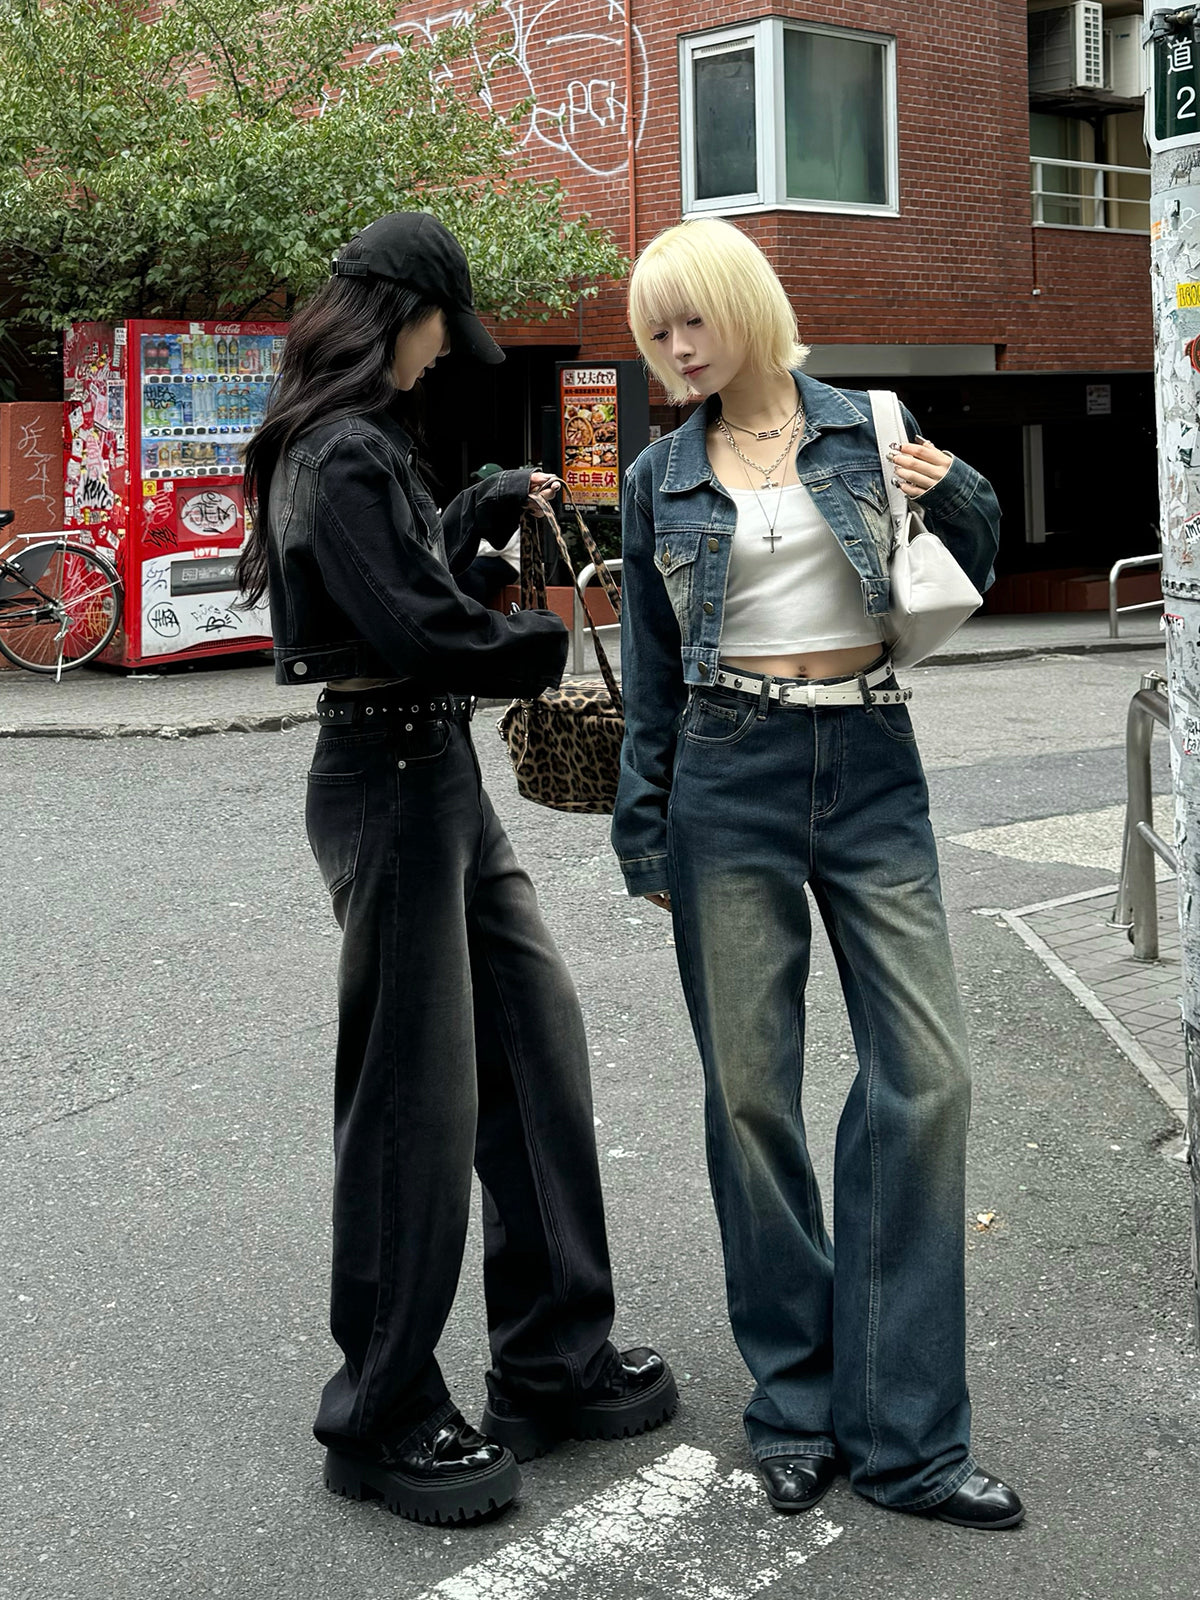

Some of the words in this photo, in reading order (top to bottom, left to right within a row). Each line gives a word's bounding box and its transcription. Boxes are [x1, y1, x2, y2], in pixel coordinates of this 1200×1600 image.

[1167, 36, 1194, 75] 道
[1176, 86, 1196, 120] 2
[567, 471, 616, 487] 年中無休
